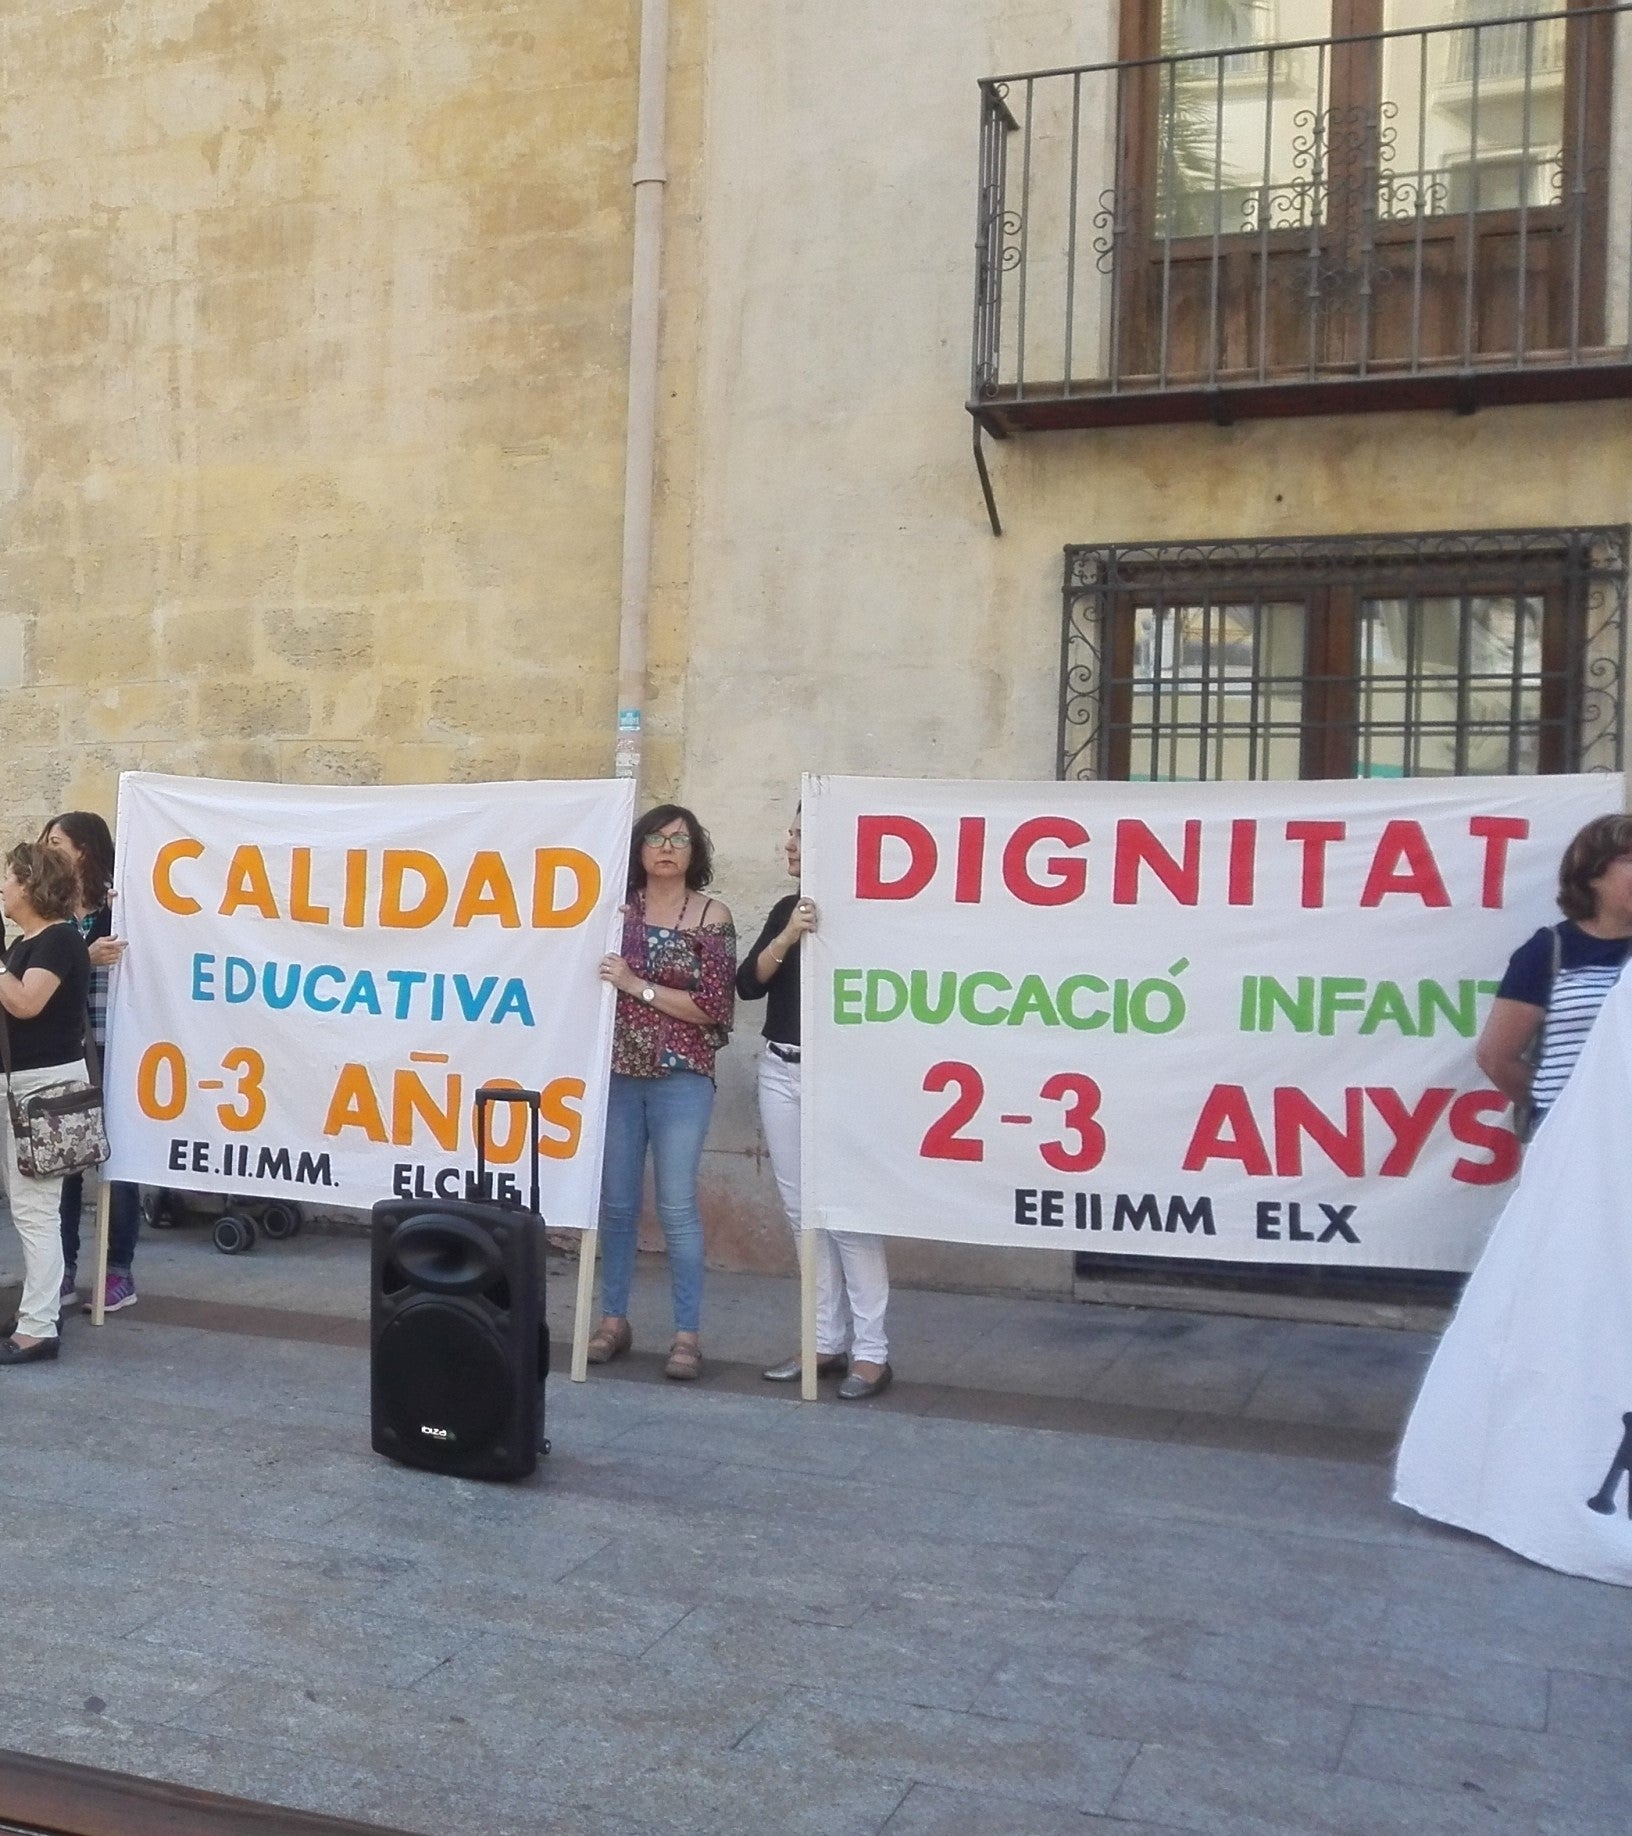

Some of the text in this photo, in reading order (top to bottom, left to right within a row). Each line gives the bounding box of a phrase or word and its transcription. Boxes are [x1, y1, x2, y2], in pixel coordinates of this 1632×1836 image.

[152, 838, 602, 930] CALIDAD
[855, 814, 1530, 910] DIGNITAT
[191, 952, 536, 1028] EDUCATIVA
[832, 957, 1189, 1036] EDUCACIÓ
[137, 1041, 587, 1164] 0-3 AÑOS
[920, 1060, 1521, 1187] 2-3 ANYS
[1256, 1201, 1362, 1244] ELX
